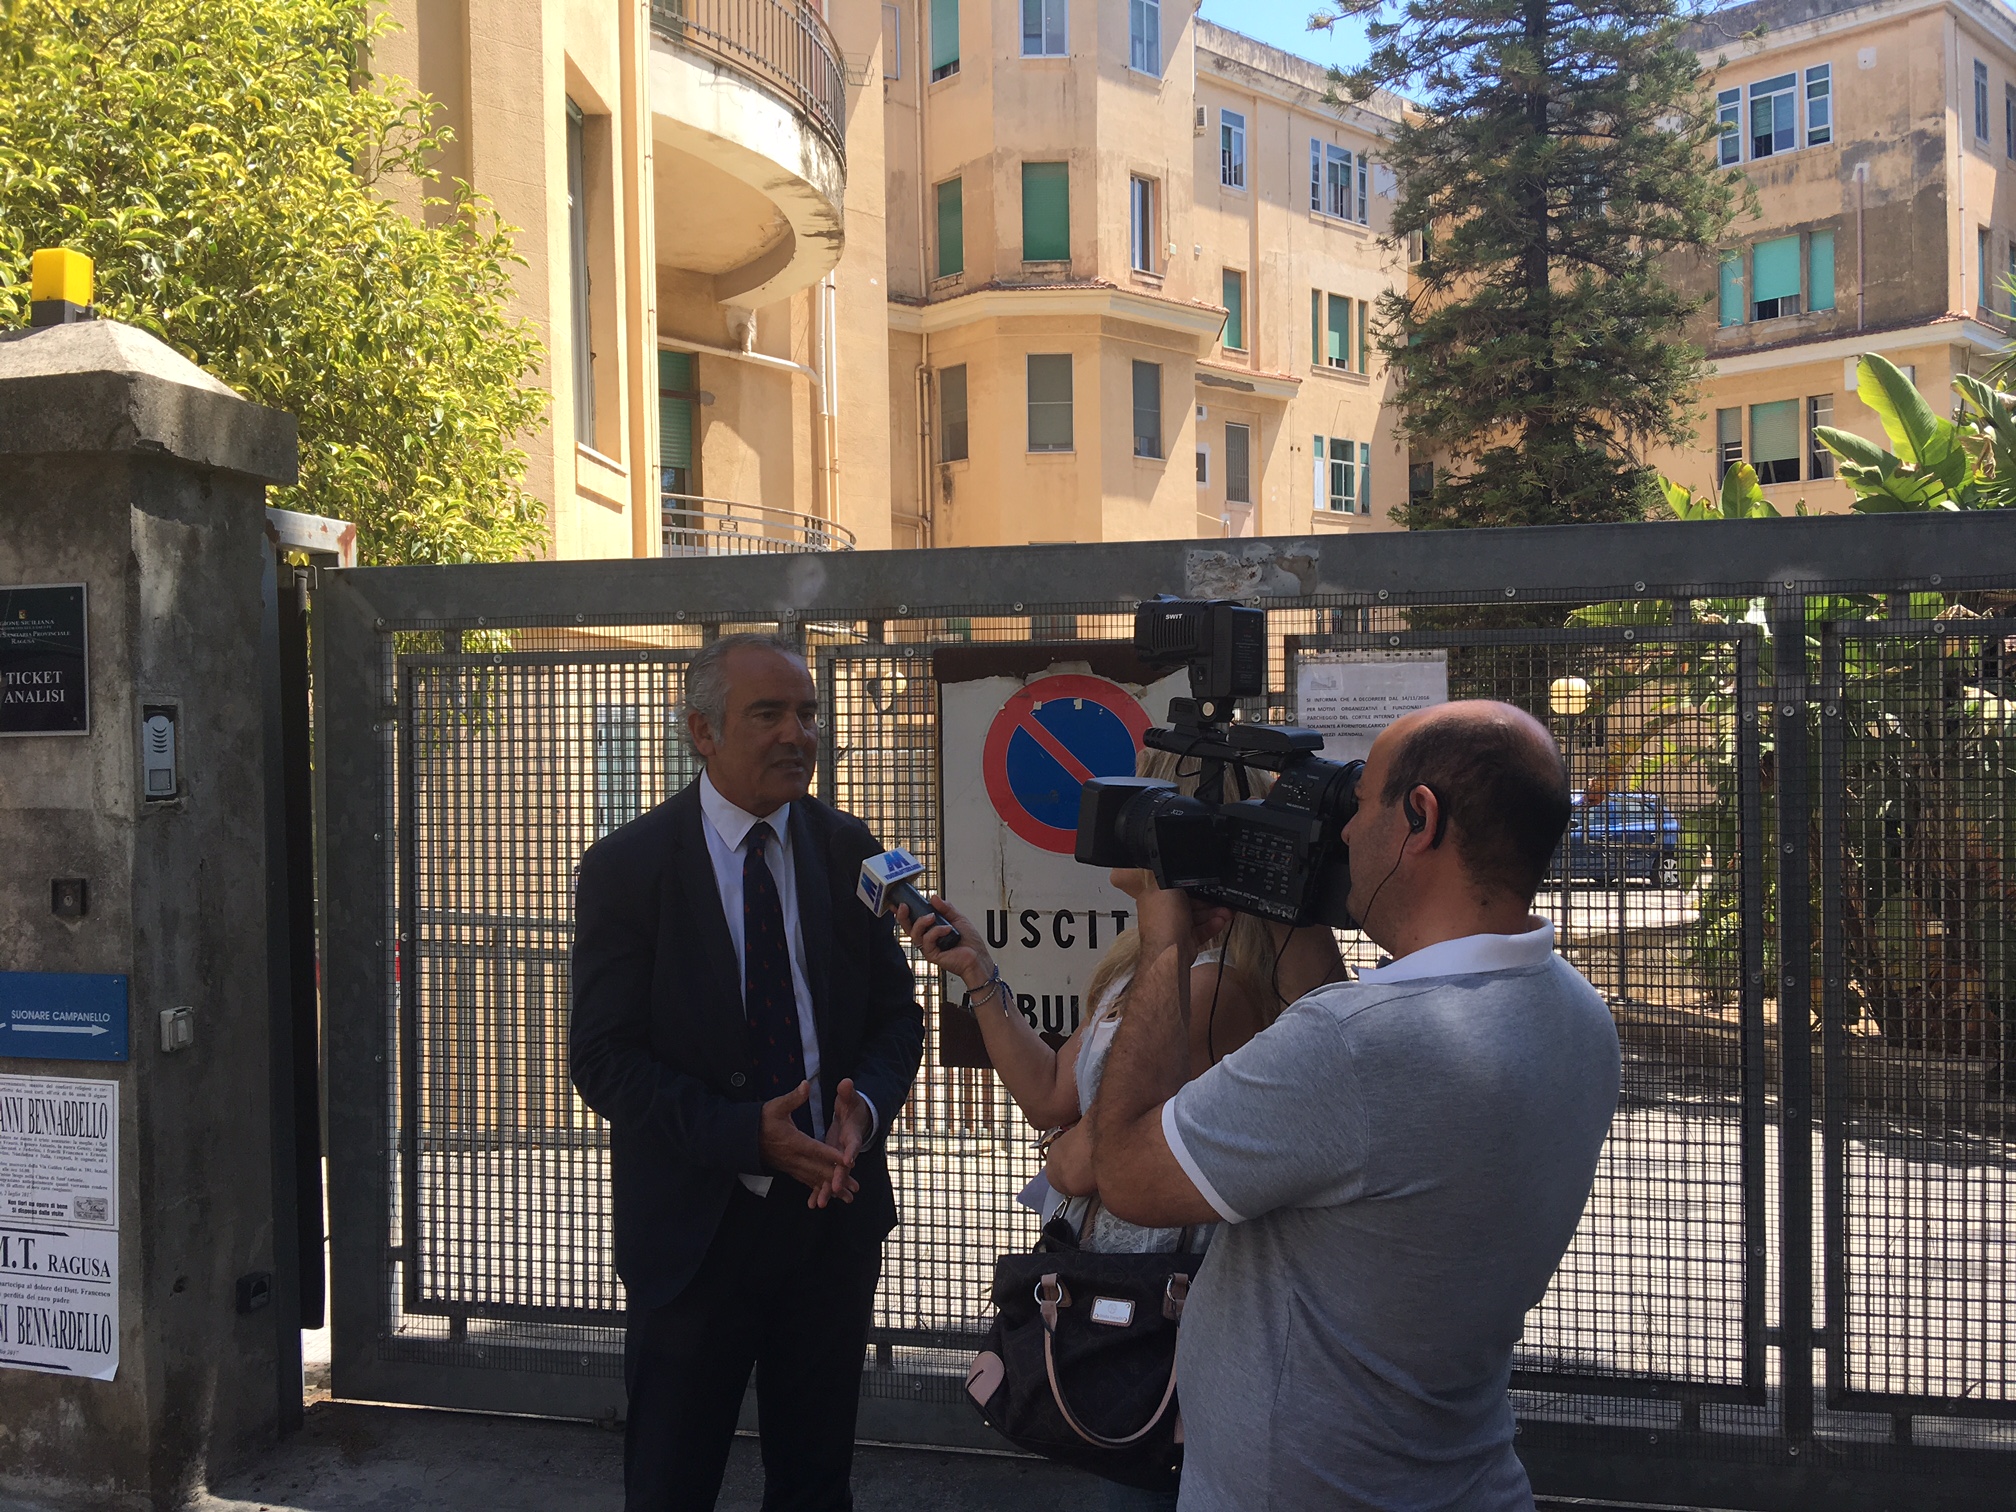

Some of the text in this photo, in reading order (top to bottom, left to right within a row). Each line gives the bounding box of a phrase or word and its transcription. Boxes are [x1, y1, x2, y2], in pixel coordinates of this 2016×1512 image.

[5, 671, 63, 685] TICKET
[4, 689, 65, 704] ANALISI
[986, 909, 1130, 949] USCIT
[11, 1009, 111, 1023] SUONARE CAMPANELLO
[28, 1098, 107, 1140] BENNARDELLO
[48, 1254, 111, 1278] RAGUSA
[3, 1292, 24, 1301] perdita
[64, 1286, 79, 1294] Dott.
[81, 1288, 111, 1297] Francesco
[17, 1305, 111, 1355] BENNARDELLO
